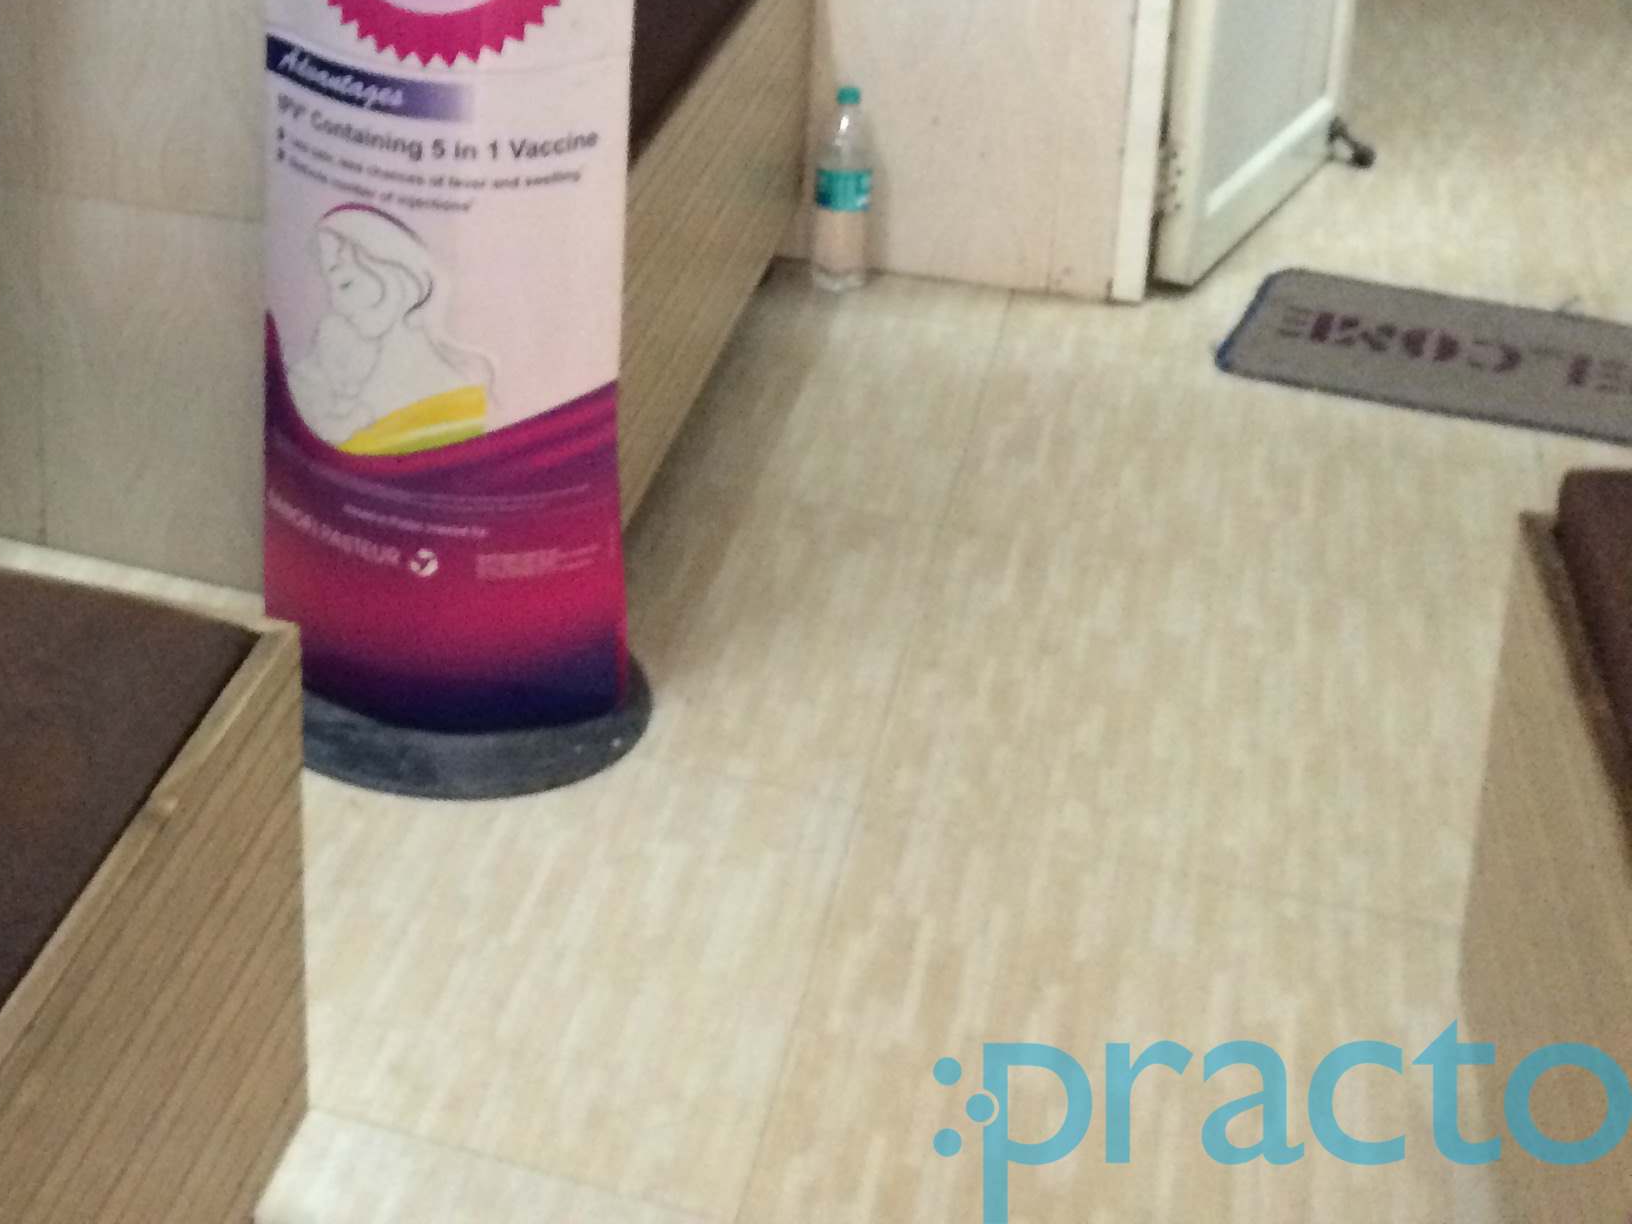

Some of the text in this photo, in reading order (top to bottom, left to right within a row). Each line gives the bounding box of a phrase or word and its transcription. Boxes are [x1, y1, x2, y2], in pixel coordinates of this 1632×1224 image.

[310, 109, 424, 163] Containing
[431, 138, 446, 160] 5
[454, 138, 478, 160] in
[488, 139, 499, 161] 1
[509, 131, 599, 160] Vaccine
